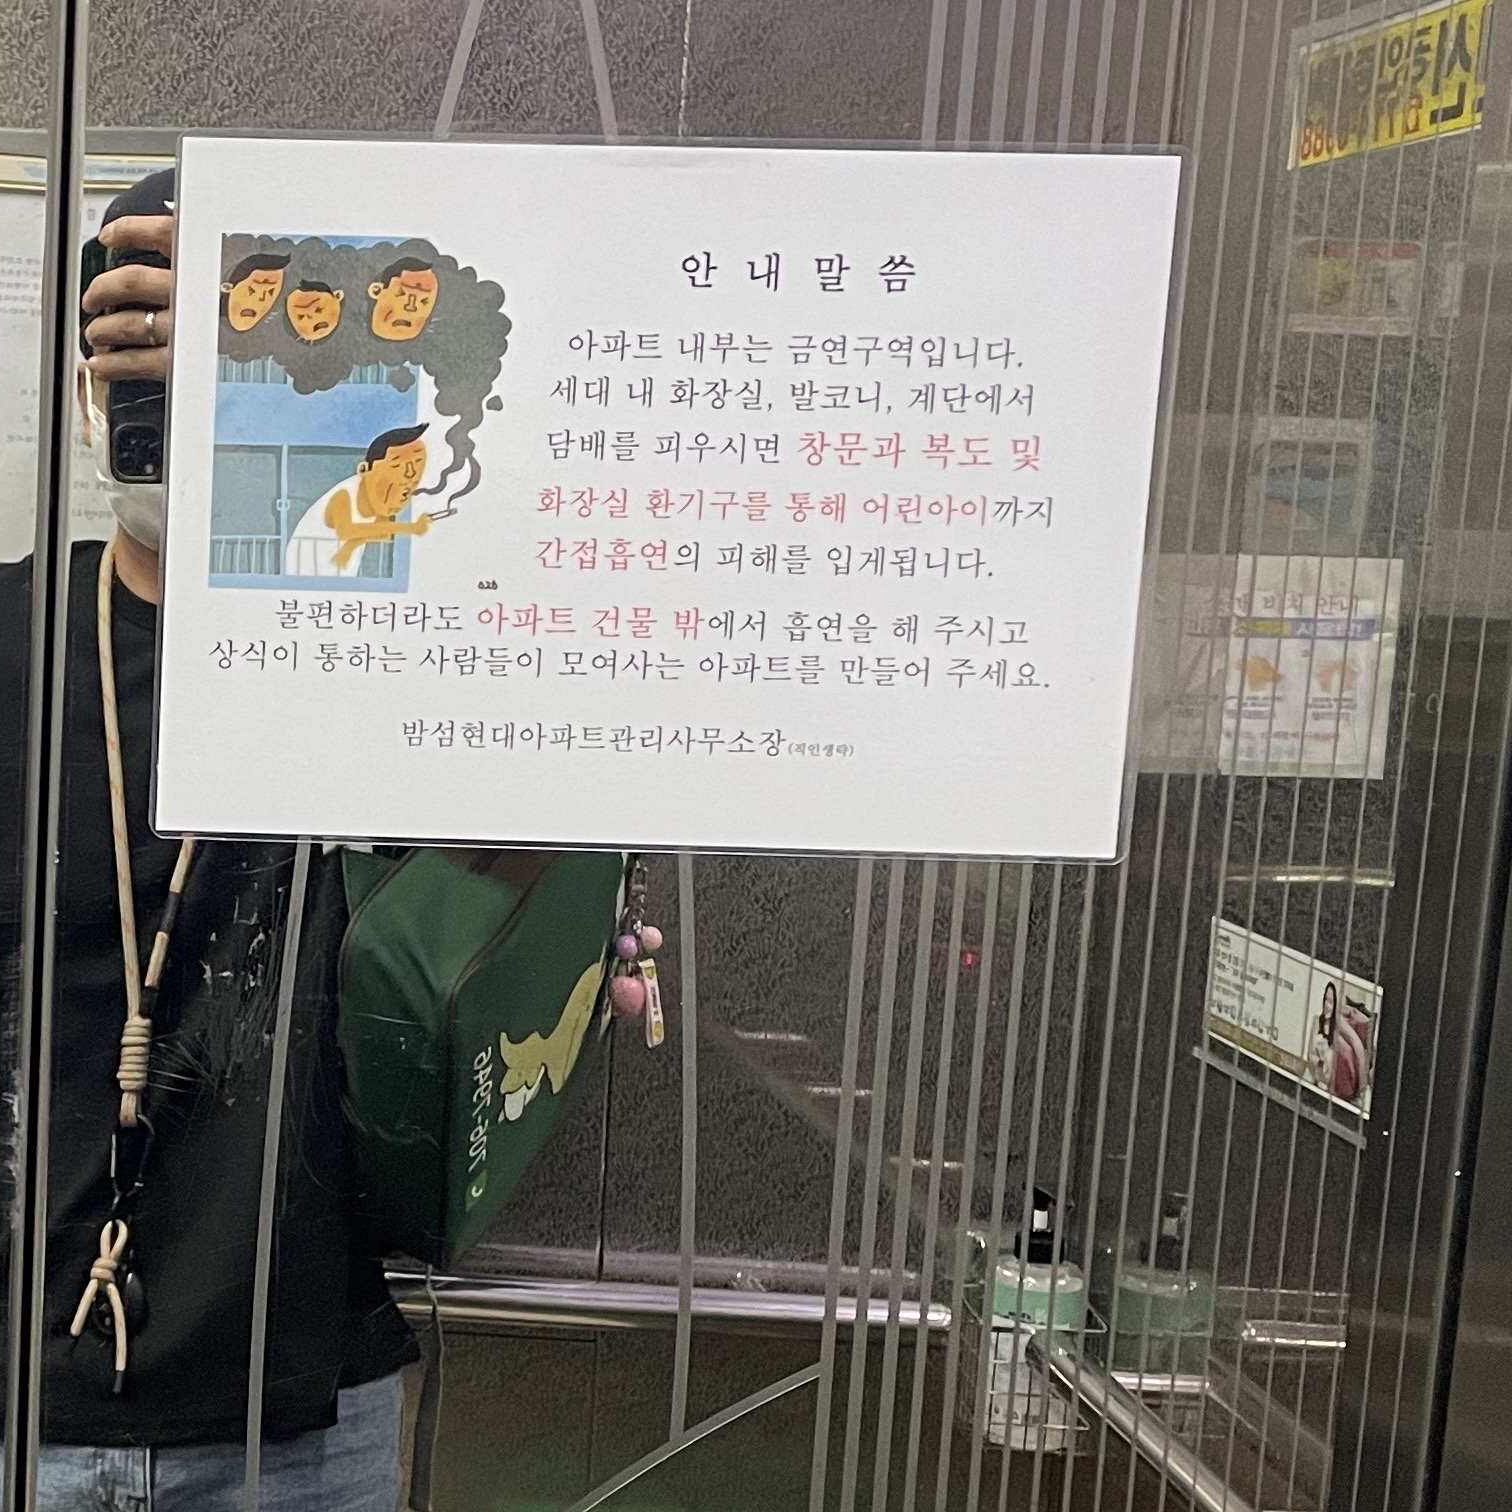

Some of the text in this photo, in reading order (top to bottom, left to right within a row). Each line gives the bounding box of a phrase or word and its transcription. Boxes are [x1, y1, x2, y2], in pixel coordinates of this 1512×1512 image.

[568, 328, 1024, 370] 아파트 내부는 금연구역입니다.
[549, 374, 1034, 417] 세대 내 화장실, 발코니, 계단에서
[546, 428, 1041, 472] 담배를 피우시면 창문과 복도 및
[536, 485, 1054, 529] 화장실 환기구를 통해 어린아이까지
[534, 536, 994, 579] 간접흡연의 피해를 입게됩니다.
[275, 598, 1029, 648] 불편하더라도 아파트 건물 밖에서 흡연을 해 주시고
[208, 638, 1050, 690] 상식이 통하는 사람들이 모여사는 아파트를 만들어 주세요.
